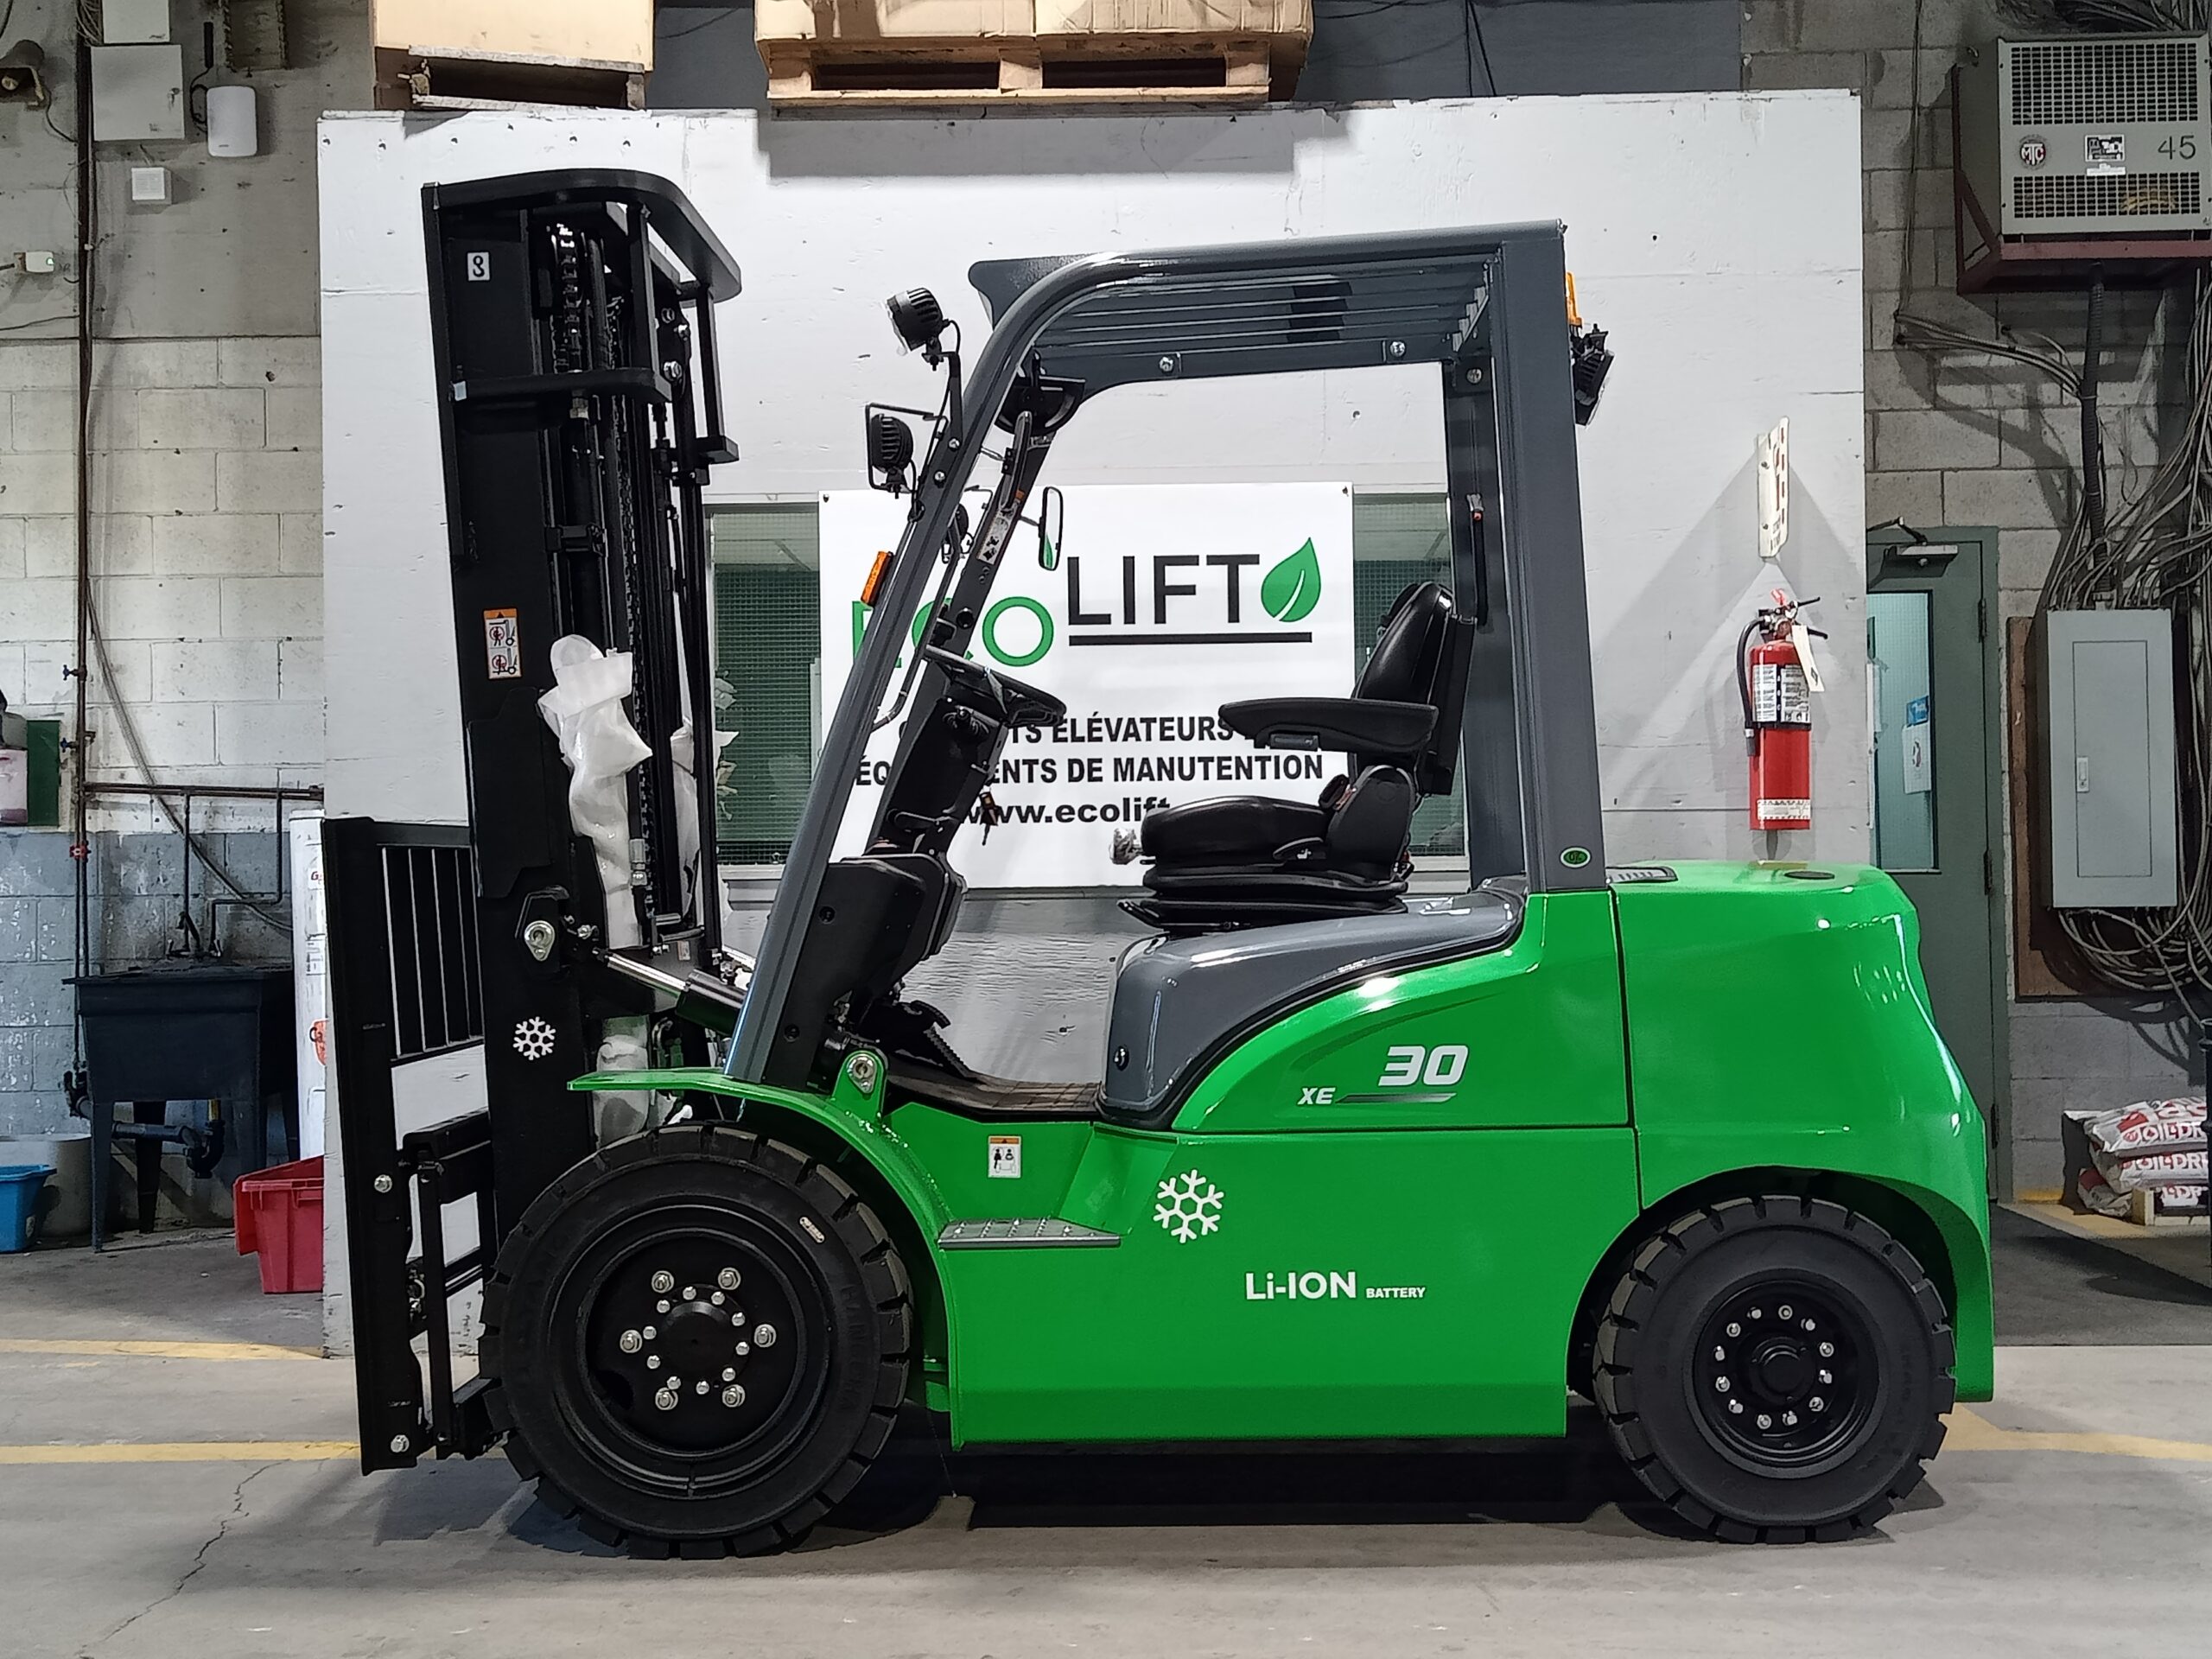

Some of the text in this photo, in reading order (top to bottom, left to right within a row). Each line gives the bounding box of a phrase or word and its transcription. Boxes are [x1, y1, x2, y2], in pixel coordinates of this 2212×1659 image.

[2158, 135, 2196, 160] 45
[1066, 554, 1260, 626] LIFT
[1068, 758, 1103, 784] DE
[1113, 754, 1323, 783] MANUTENTION
[1378, 1044, 1469, 1087] 30
[1298, 1087, 1336, 1106] XE
[1245, 1271, 1426, 1300] Li-ION BATTERY
